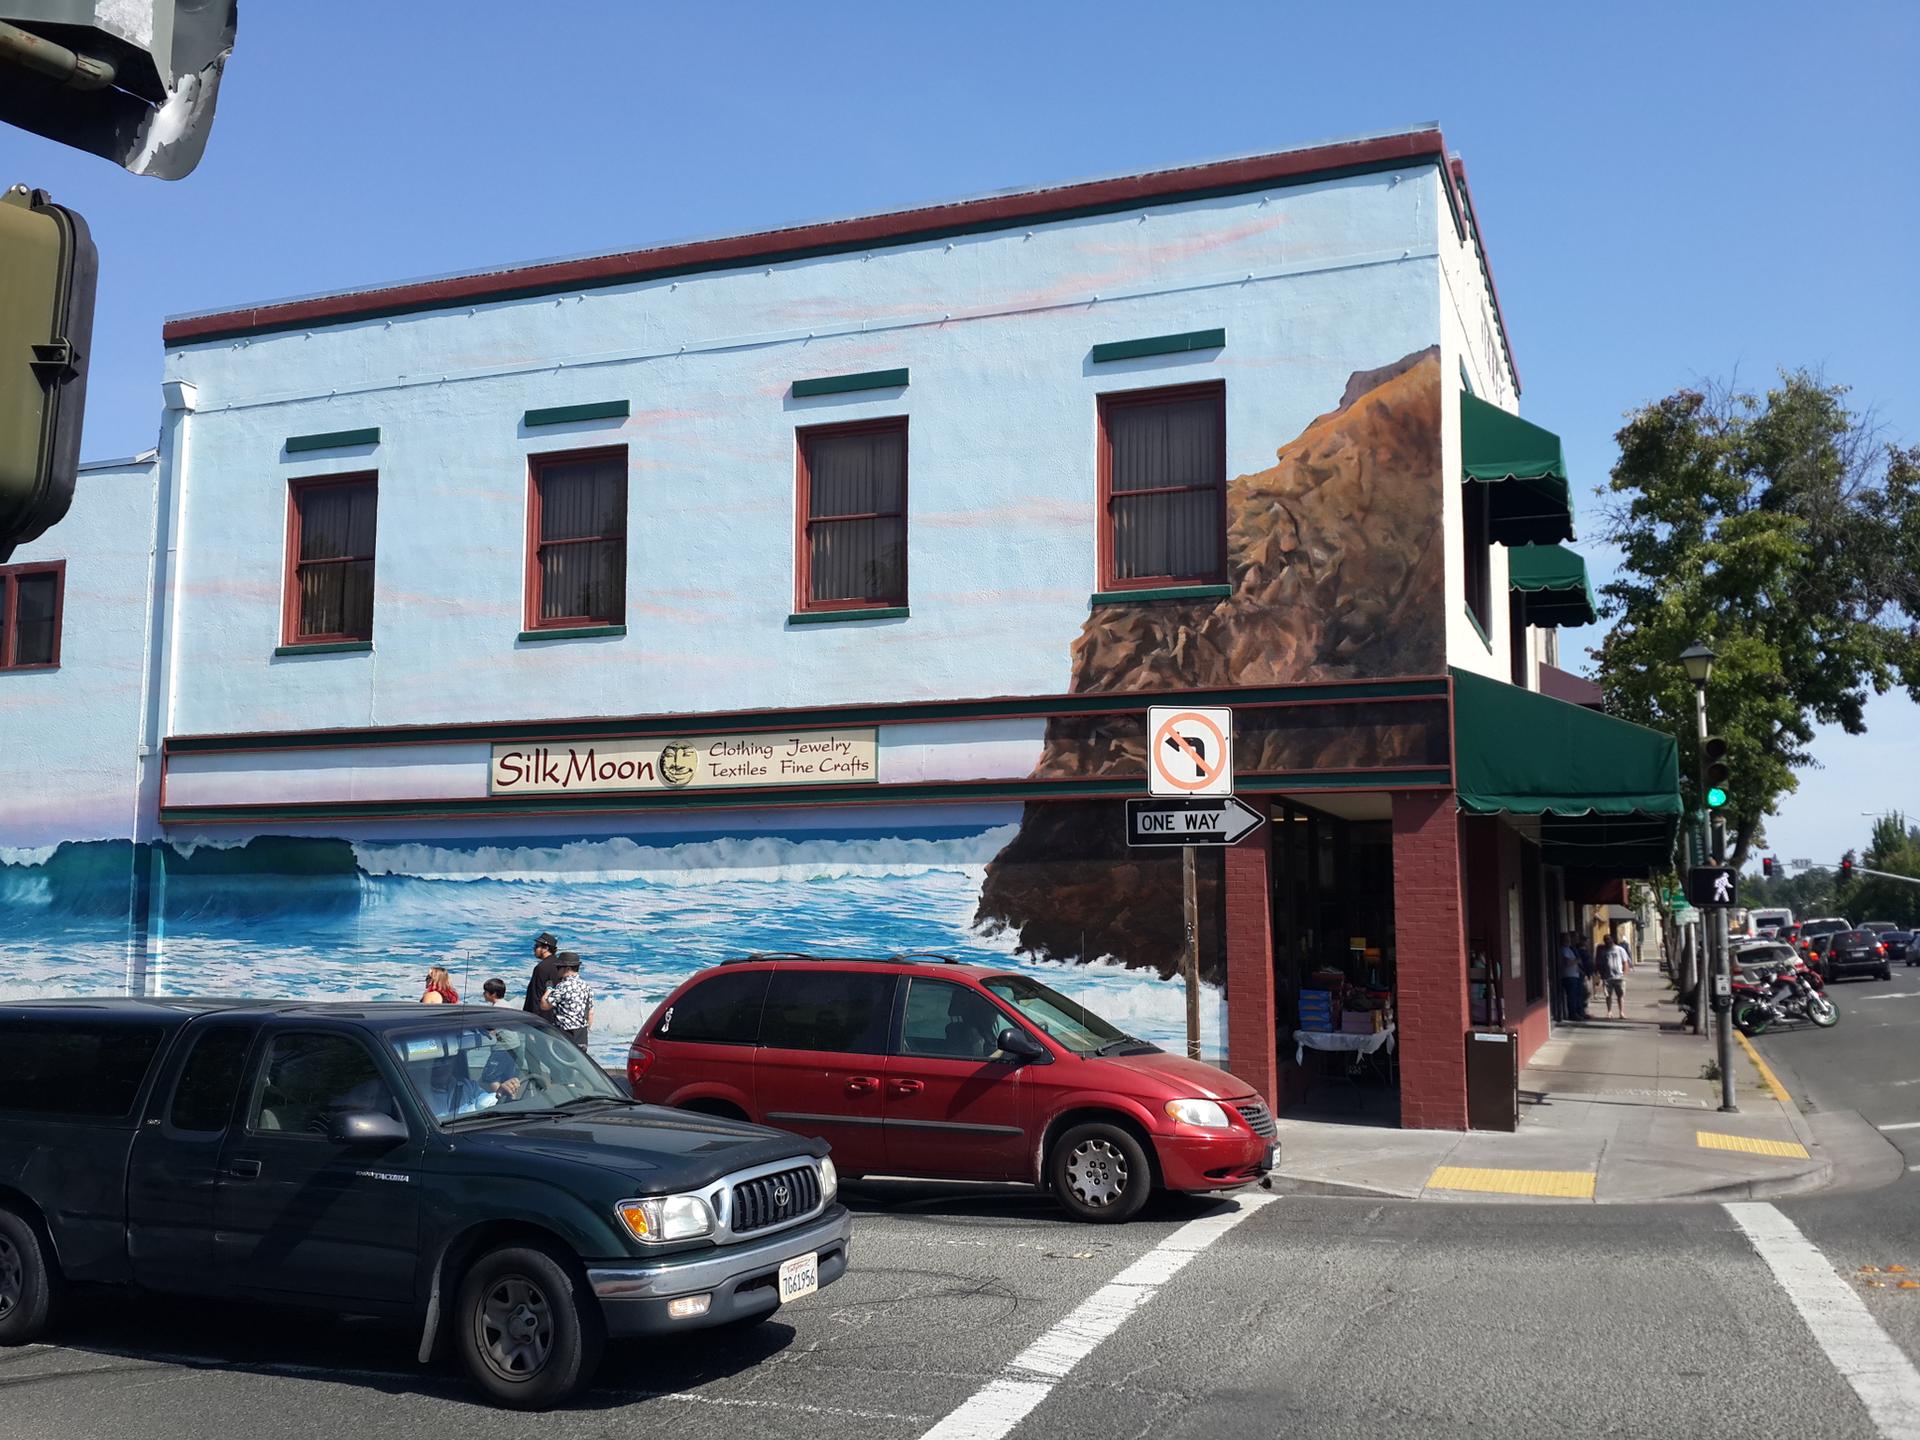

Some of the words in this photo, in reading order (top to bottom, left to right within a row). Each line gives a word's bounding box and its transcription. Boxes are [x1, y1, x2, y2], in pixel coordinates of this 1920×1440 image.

[709, 740, 774, 760] Clothing
[786, 736, 852, 757] Jewelry
[496, 747, 560, 787] Silk
[562, 747, 654, 788] Moon
[708, 761, 768, 778] Textiles
[780, 759, 815, 774] Fine
[819, 755, 870, 777] Crafts
[1141, 814, 1176, 831] ONE
[1184, 813, 1220, 830] WAY
[783, 1267, 815, 1296] 7G61956
